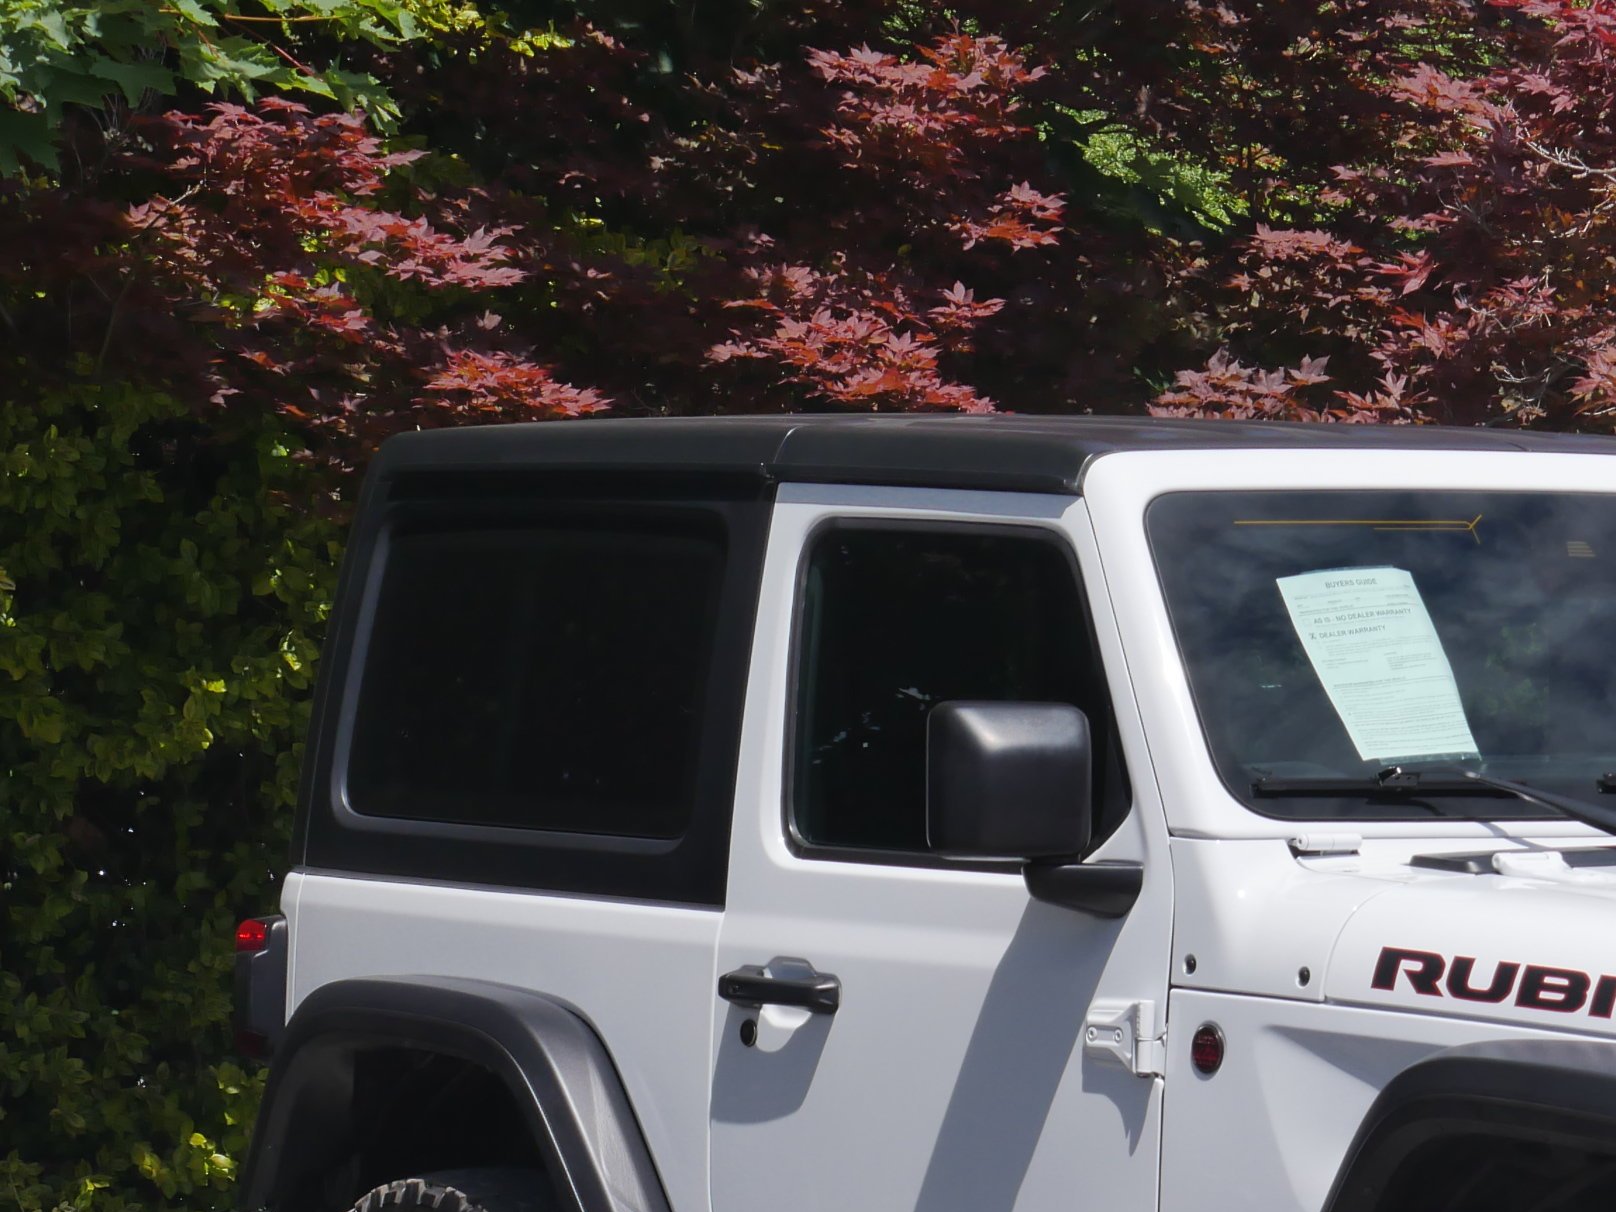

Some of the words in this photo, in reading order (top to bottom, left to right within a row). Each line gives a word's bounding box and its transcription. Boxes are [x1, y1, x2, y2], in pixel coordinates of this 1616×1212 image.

[1325, 579, 1354, 589] BUYERS
[1356, 578, 1378, 586] GUIDE
[1348, 611, 1376, 620] DEALER
[1377, 608, 1411, 617] WARRANTY
[1319, 630, 1346, 639] DEALER
[1348, 625, 1386, 636] WARRANTY
